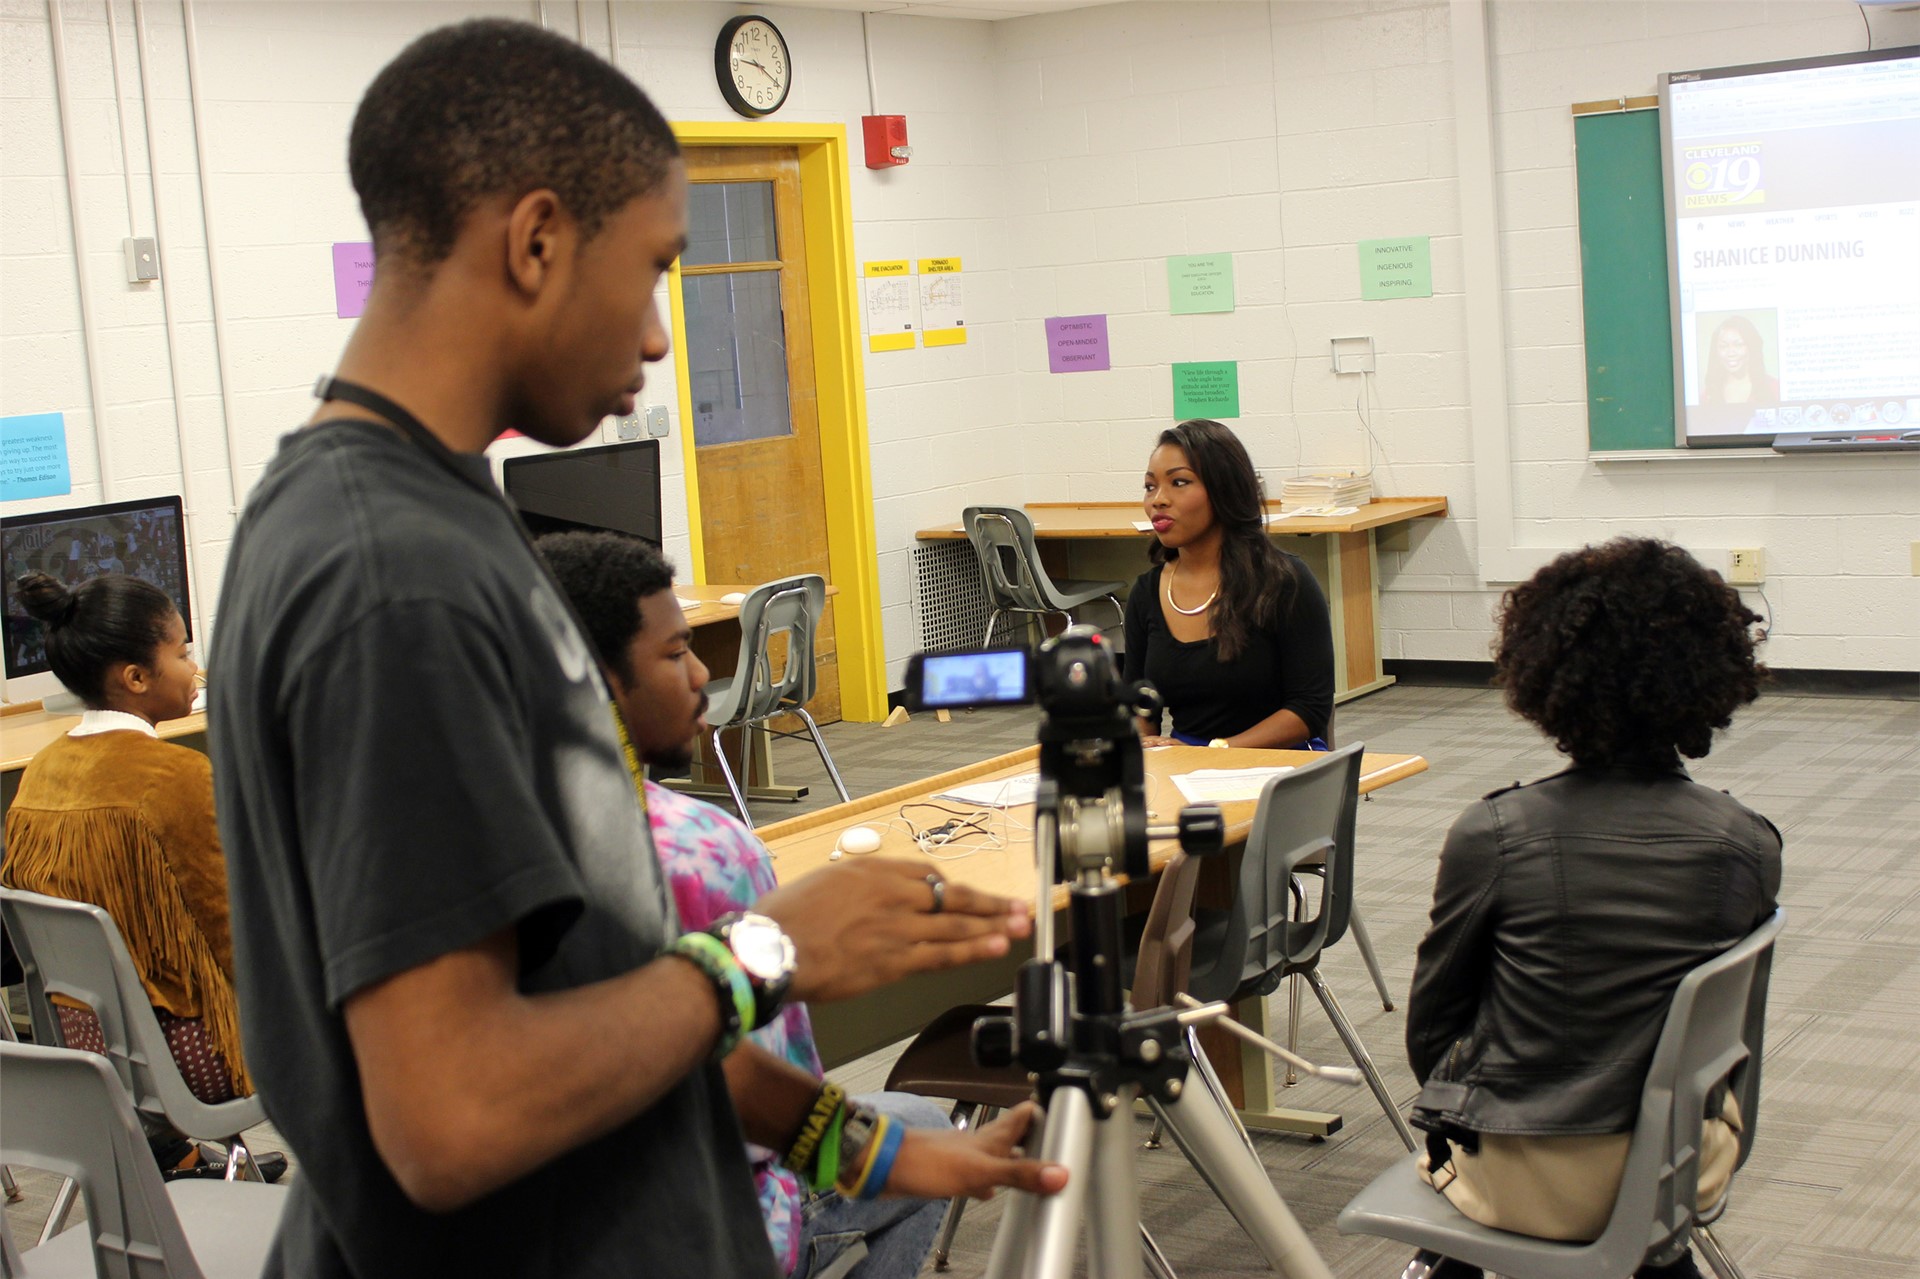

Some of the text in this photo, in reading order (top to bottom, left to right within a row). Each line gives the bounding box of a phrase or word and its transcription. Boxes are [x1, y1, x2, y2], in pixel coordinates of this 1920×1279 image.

[741, 31, 749, 44] 11
[750, 27, 760, 41] 12
[764, 33, 768, 46] 1
[734, 42, 744, 56] 10
[771, 45, 778, 58] 2
[732, 58, 739, 72] 9
[776, 60, 782, 74] 3
[738, 75, 744, 88] 8
[746, 86, 752, 99] 7
[757, 90, 764, 104] 6
[767, 88, 773, 100] 5
[1685, 145, 1760, 160] CLEVELAND
[1707, 156, 1760, 203] 19
[1687, 193, 1728, 206] NEWS
[1375, 244, 1412, 254] INNOVATIVE
[1694, 240, 1864, 269] SHANICE DUNNING
[1377, 262, 1413, 270] INGENIOUS
[1379, 279, 1412, 288] INSPIRING
[1060, 323, 1092, 331] OPTIMISTIC
[1058, 338, 1098, 346] OPEN-MINDED
[1062, 354, 1096, 362] OBSERVANT
[2, 435, 53, 446] greatest weakness
[4, 448, 21, 456] giving
